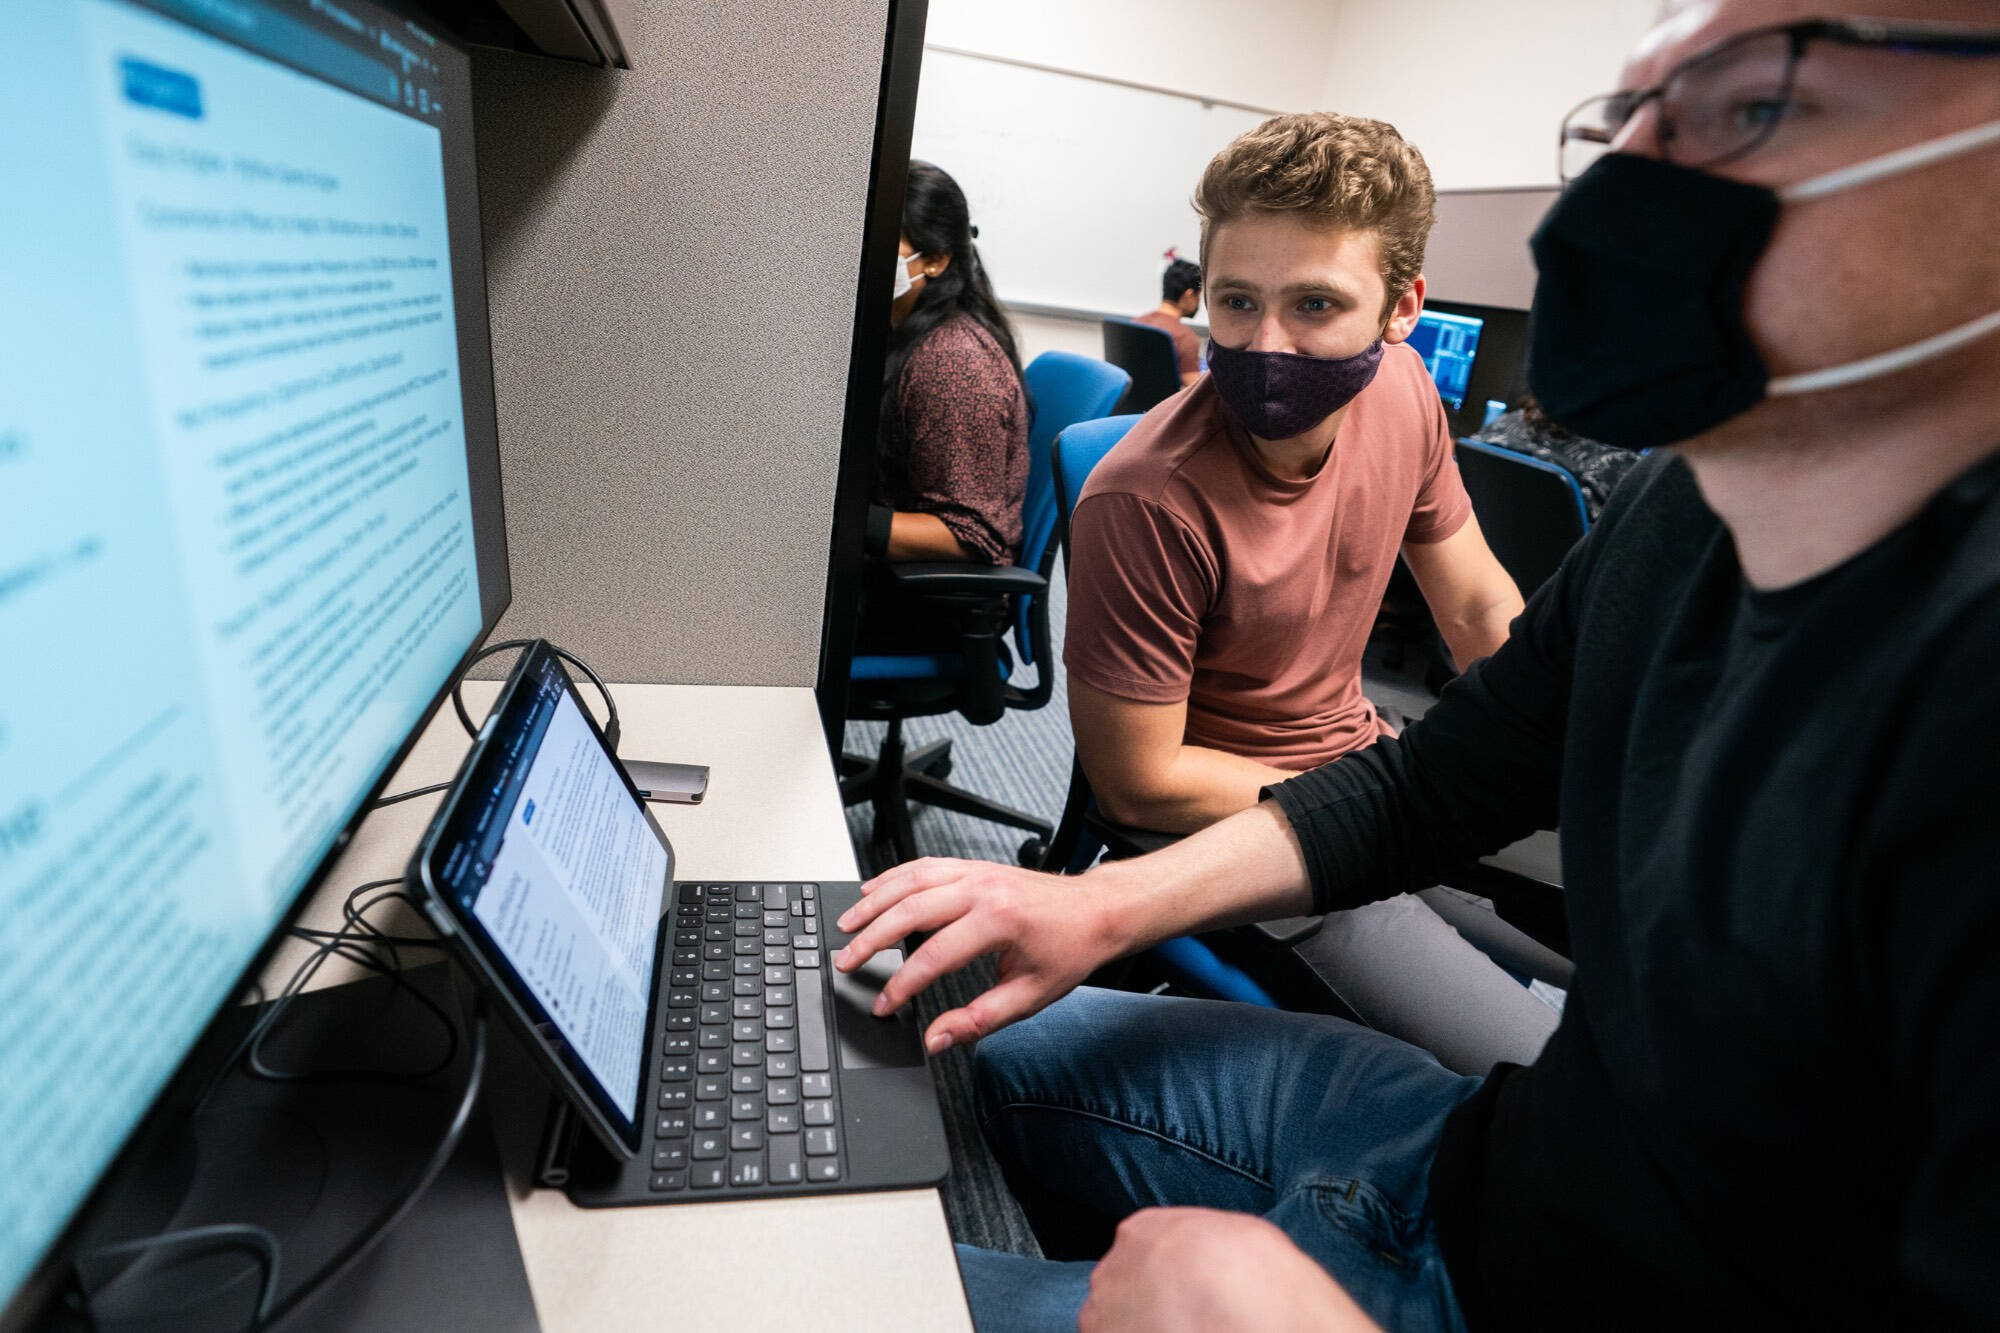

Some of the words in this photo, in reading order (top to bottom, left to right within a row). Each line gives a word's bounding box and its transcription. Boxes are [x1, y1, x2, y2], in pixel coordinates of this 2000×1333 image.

[773, 971, 782, 979] M
[743, 1003, 752, 1011] H
[681, 1016, 692, 1024] 6
[741, 1026, 753, 1034] G
[775, 1037, 785, 1045] V
[707, 1057, 717, 1065] R
[677, 1065, 687, 1073] 4
[775, 1061, 786, 1070] C
[741, 1075, 752, 1084] D
[705, 1084, 717, 1092] E
[777, 1088, 787, 1096] X
[674, 1091, 686, 1099] 3
[740, 1102, 753, 1111] S
[705, 1110, 716, 1121] W
[777, 1115, 789, 1124] Z
[672, 1119, 685, 1128] 2
[741, 1131, 752, 1140] A
[703, 1140, 716, 1150] Q
[670, 1150, 681, 1159] 1
